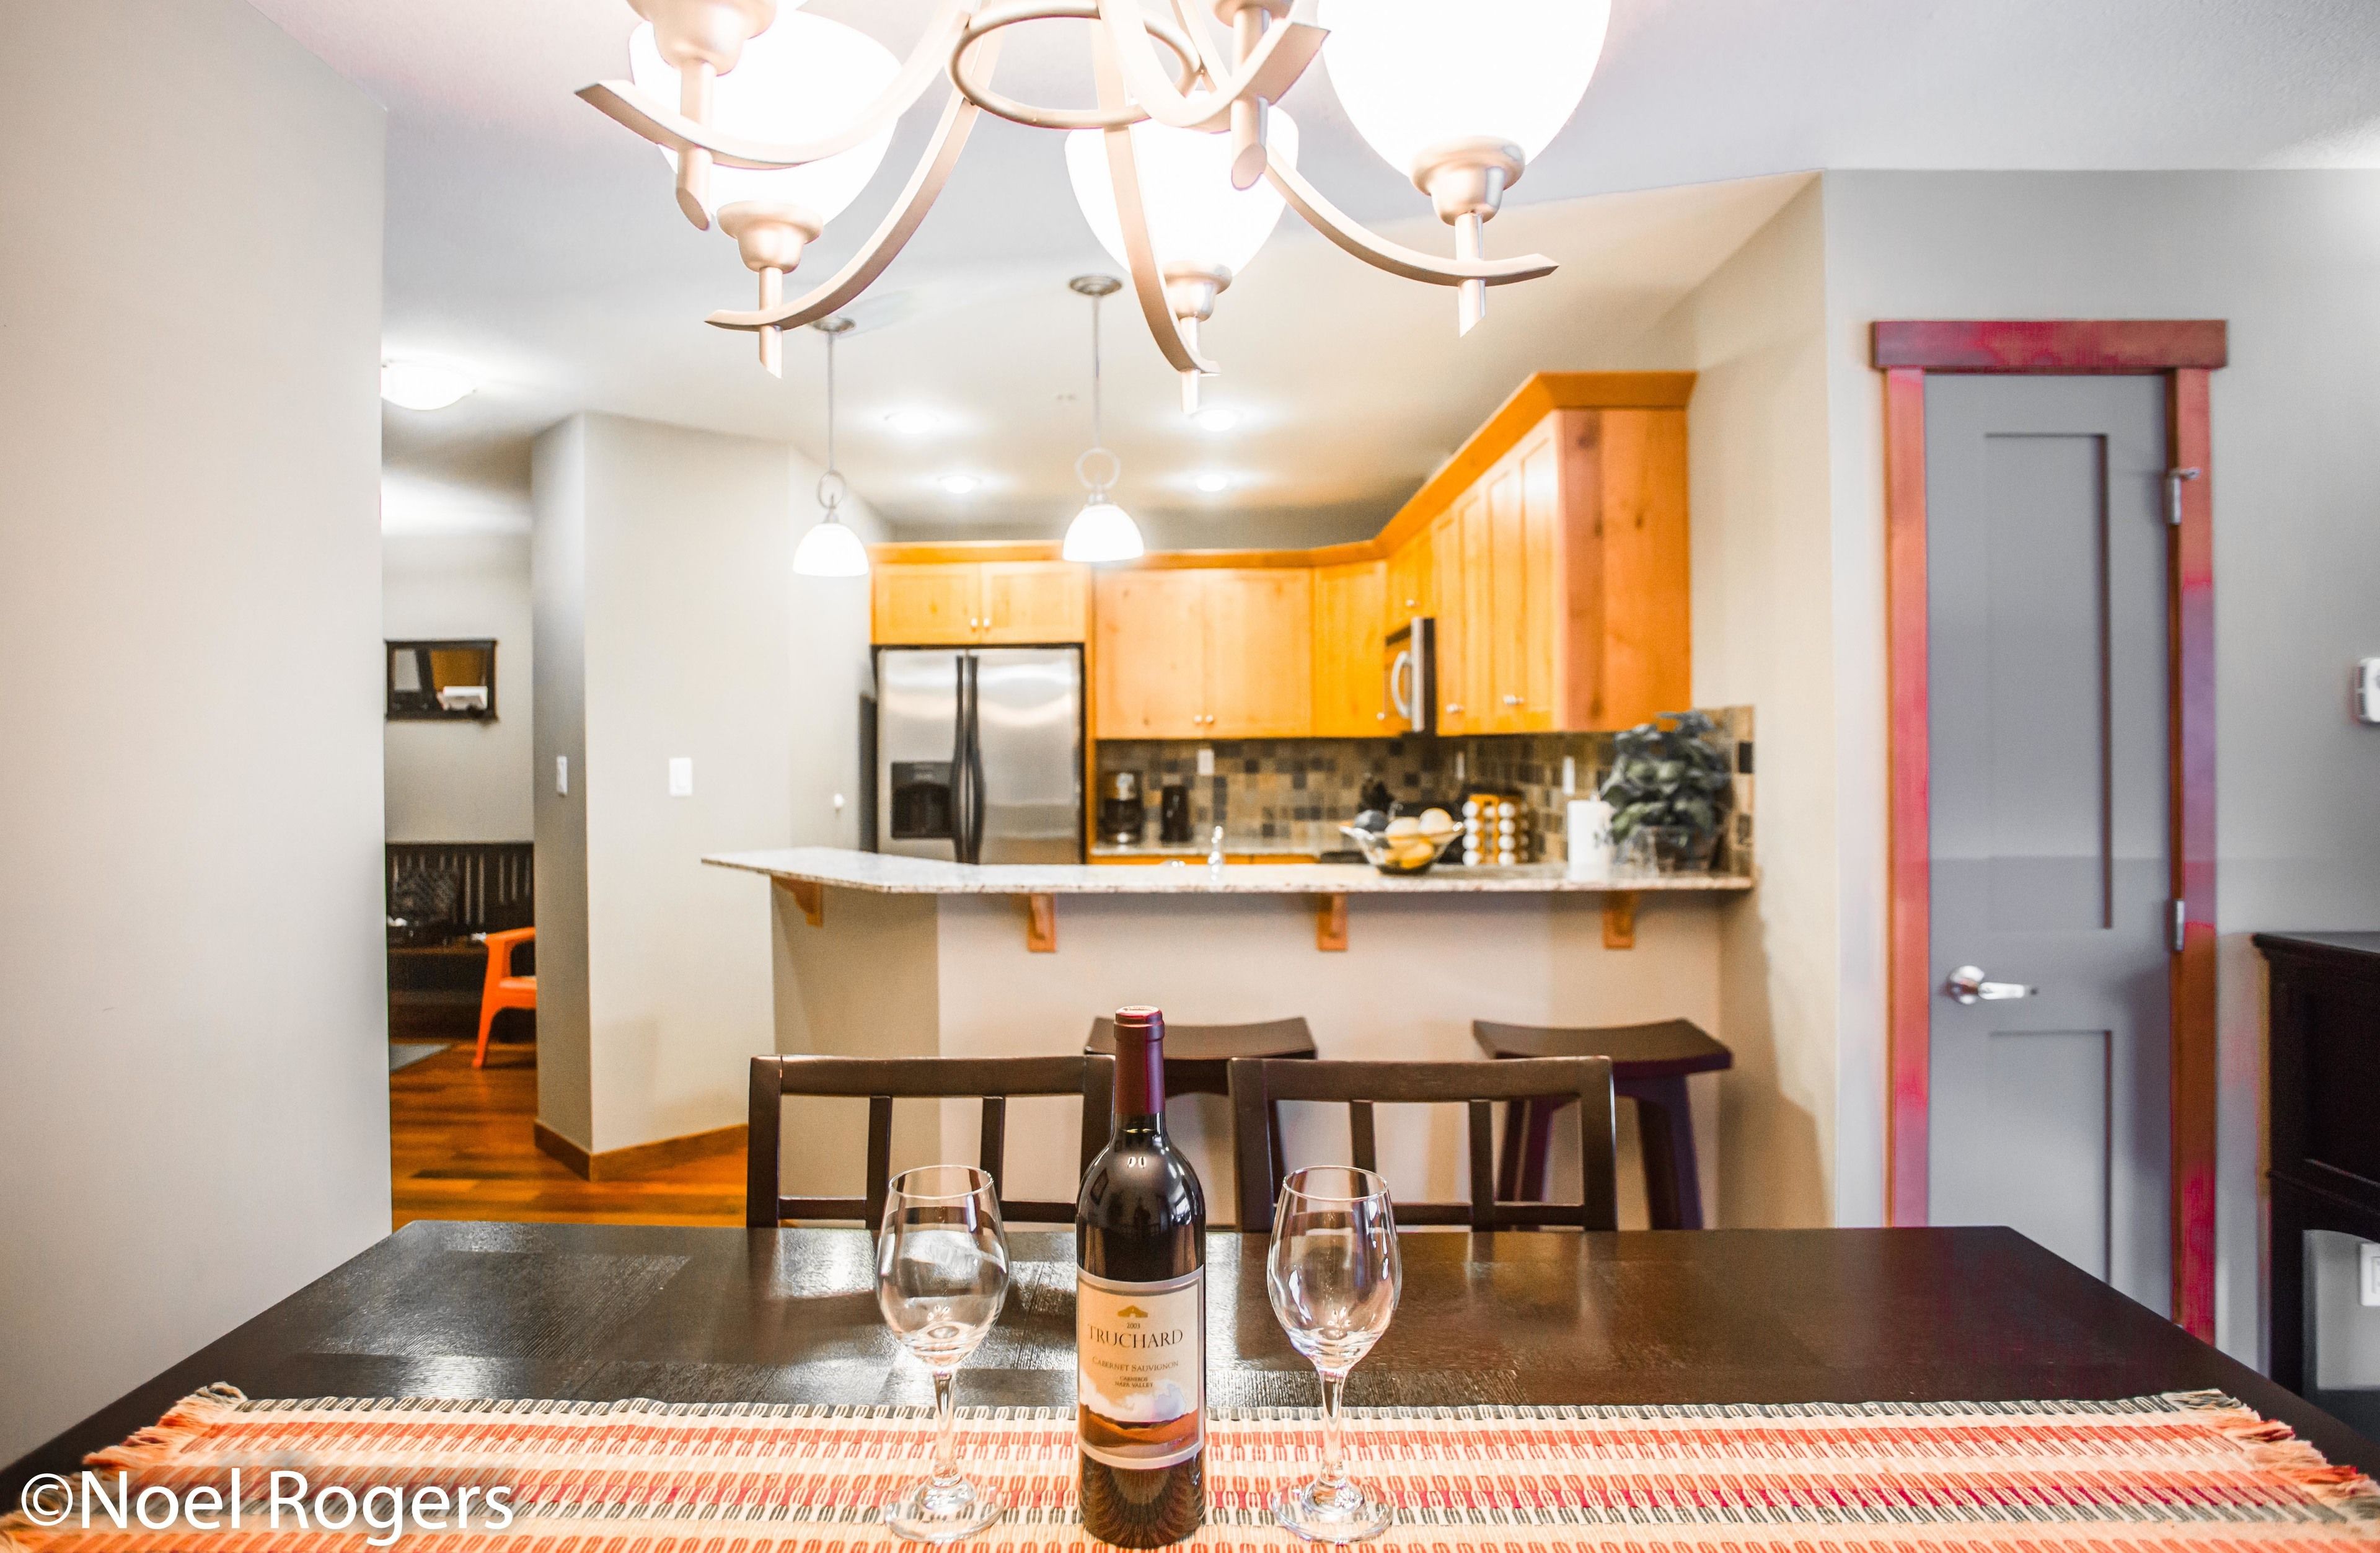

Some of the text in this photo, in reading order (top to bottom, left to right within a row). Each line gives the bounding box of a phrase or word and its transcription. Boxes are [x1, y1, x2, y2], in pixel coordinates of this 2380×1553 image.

[1088, 1324, 1183, 1348] TRUCHARD
[1092, 1355, 1179, 1372] CABERNET SAUVIGNON
